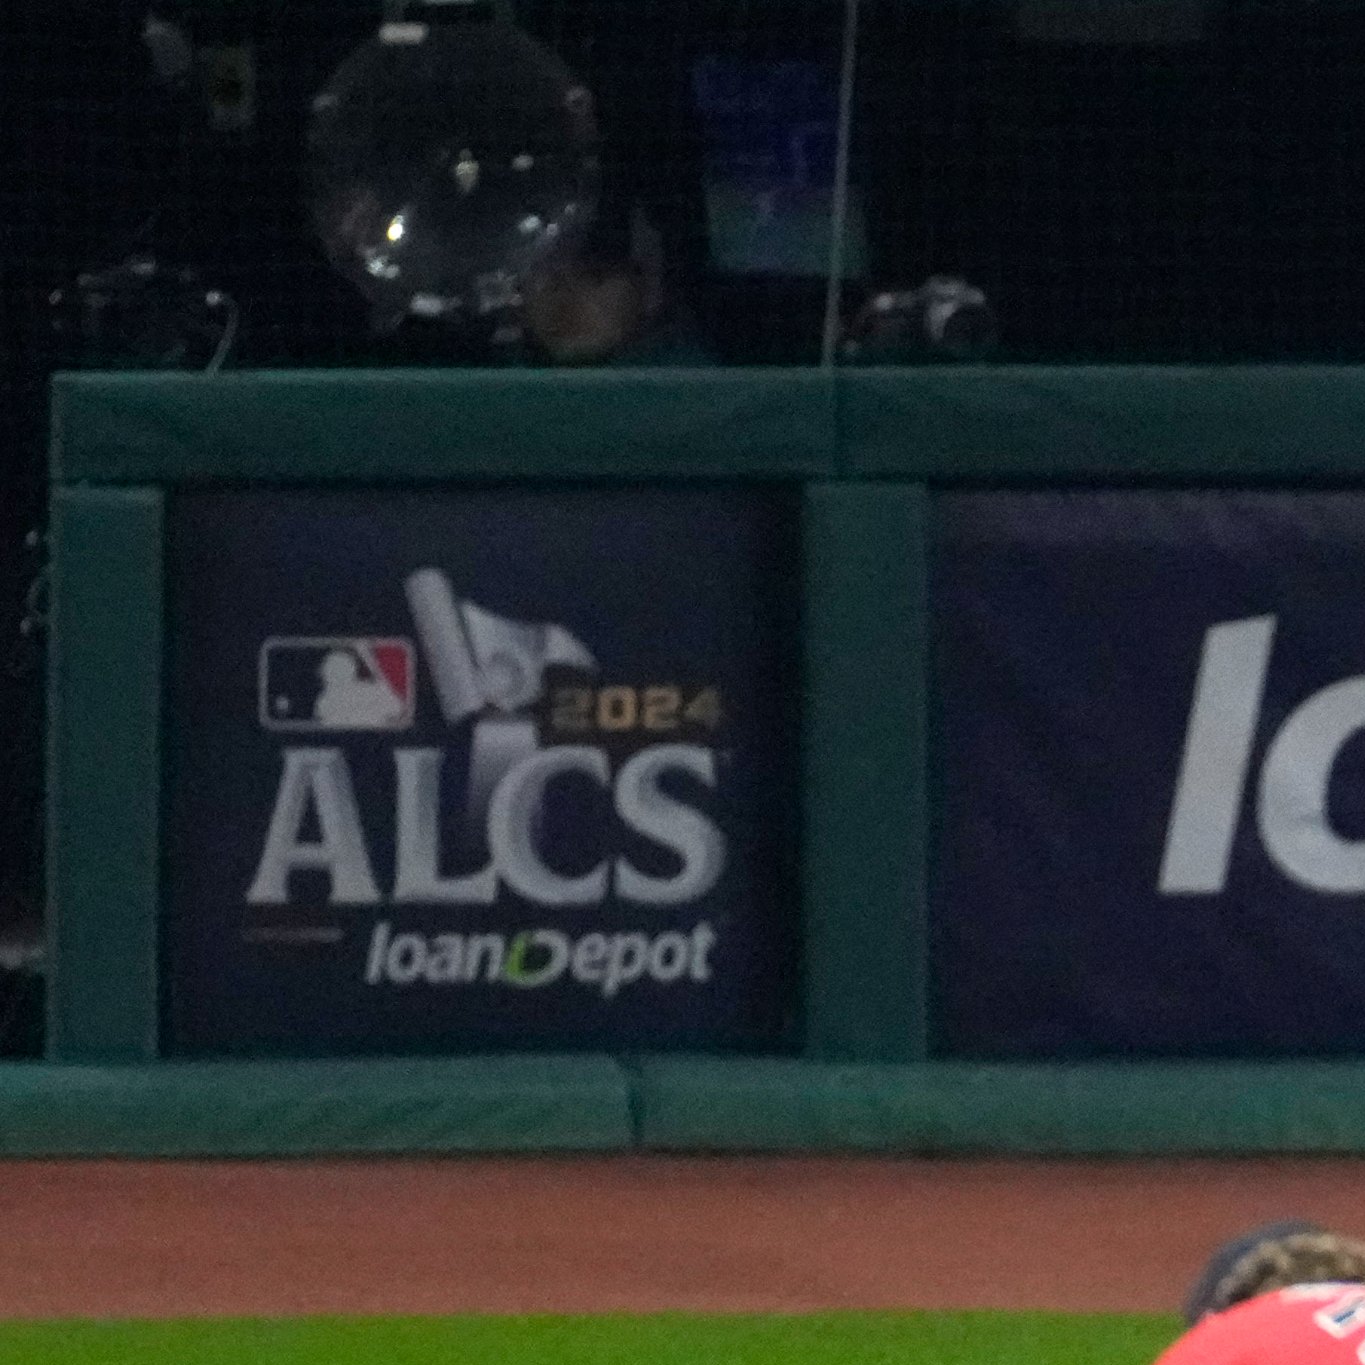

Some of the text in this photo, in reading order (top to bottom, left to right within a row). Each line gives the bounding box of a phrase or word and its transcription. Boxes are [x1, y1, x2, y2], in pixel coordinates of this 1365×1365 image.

[550, 684, 722, 732] 2024
[246, 742, 728, 907] ALCS
[364, 920, 716, 998] loanDepot
